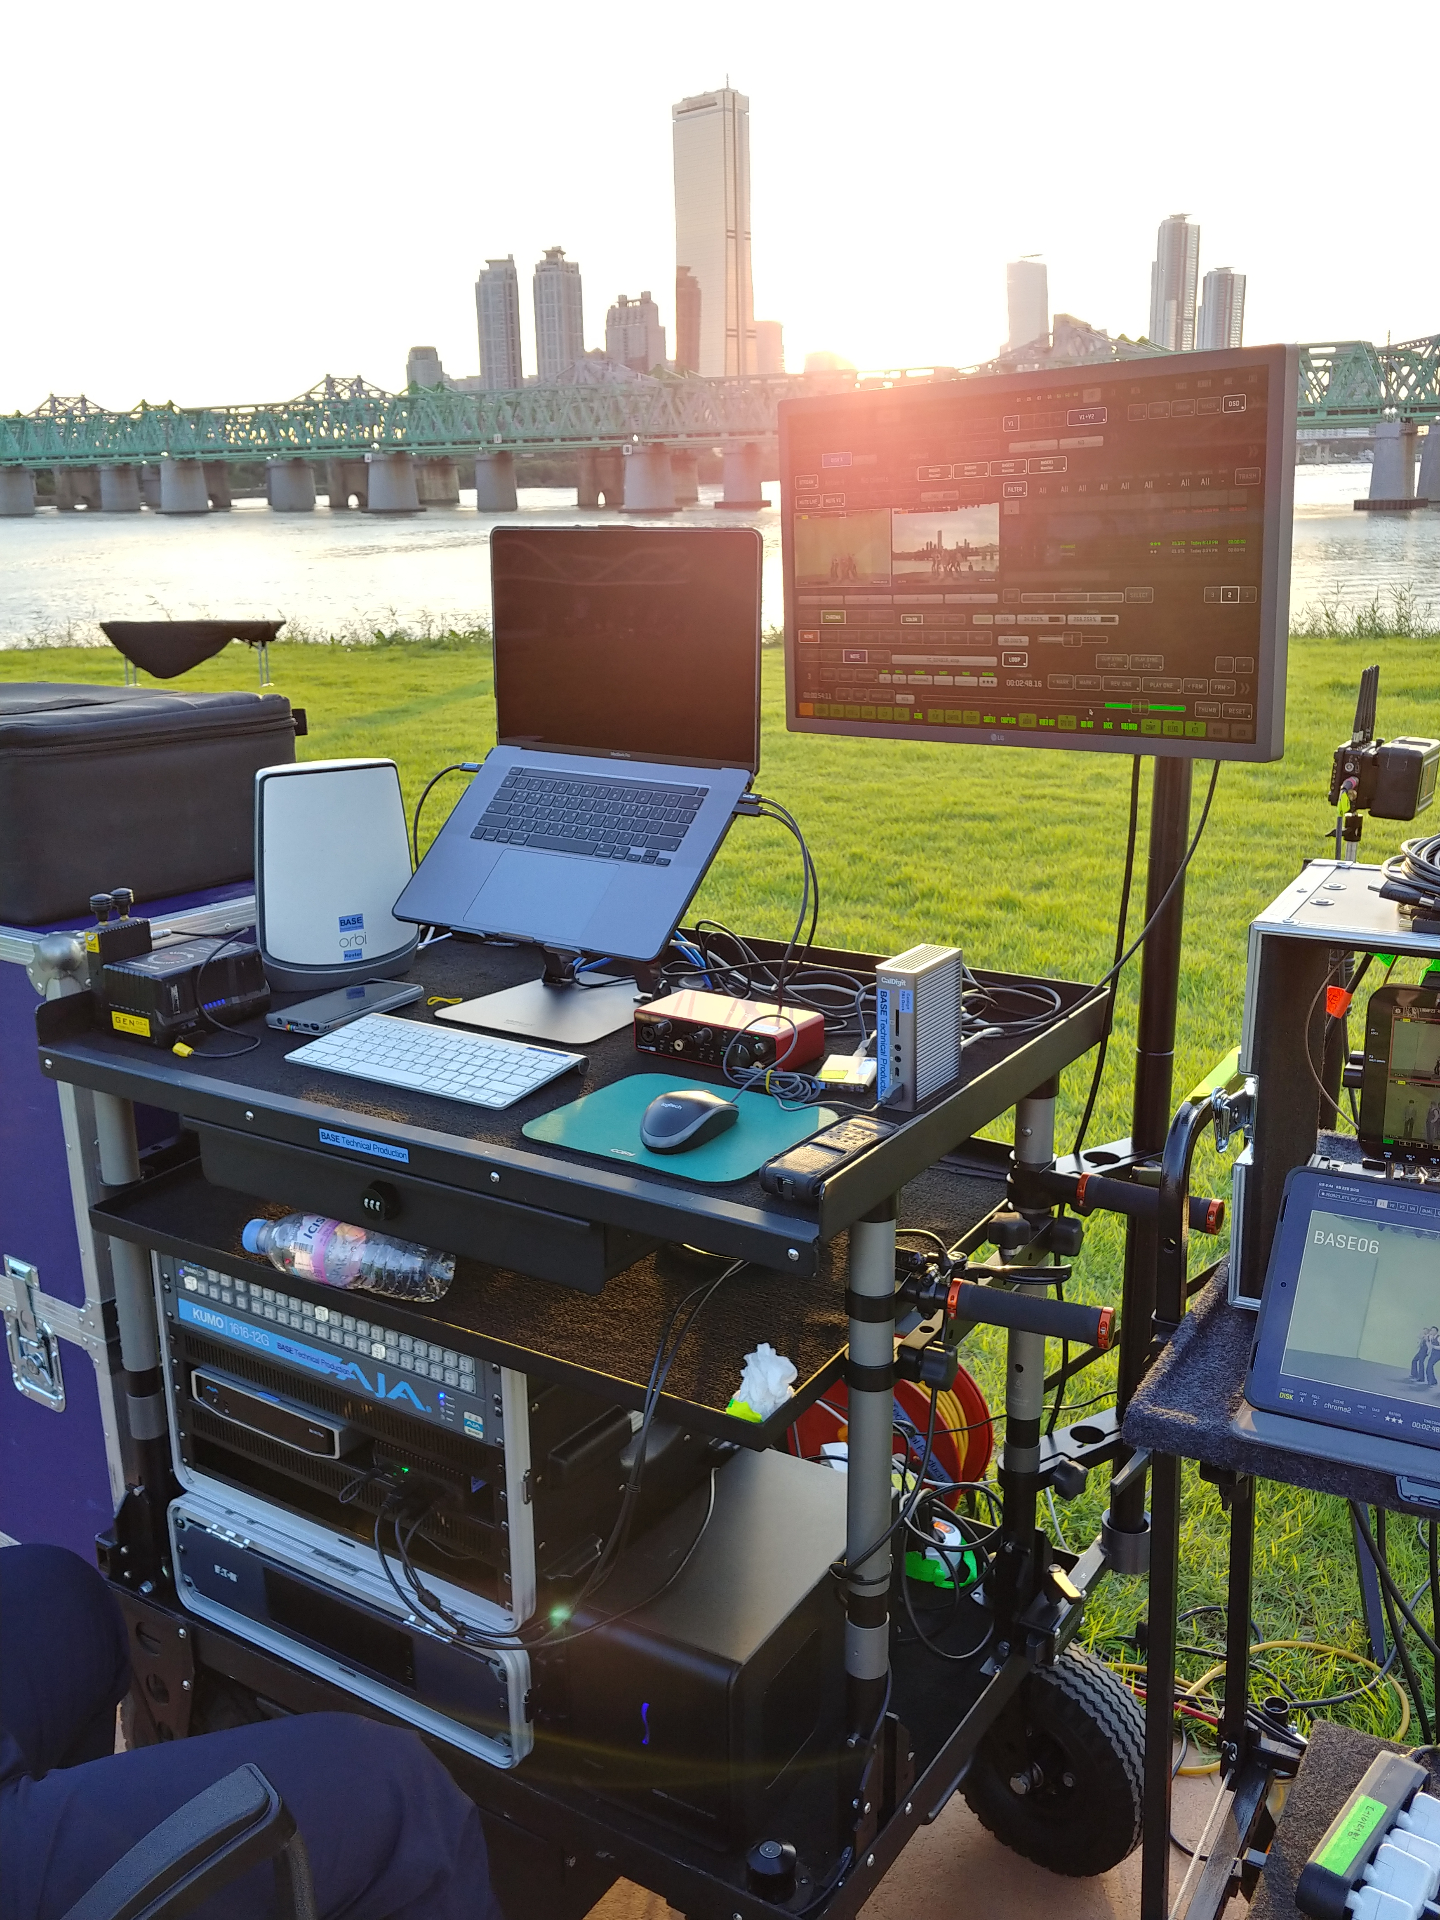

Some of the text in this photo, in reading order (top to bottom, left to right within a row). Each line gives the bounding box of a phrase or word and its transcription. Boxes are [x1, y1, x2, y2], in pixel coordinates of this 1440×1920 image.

[340, 916, 363, 926] BASE
[339, 931, 368, 948] orbi
[881, 976, 907, 987] CalDigit
[880, 990, 888, 1016] BASE
[115, 1016, 135, 1026] GEN
[879, 1018, 888, 1056] Technical
[660, 1101, 683, 1110] logitech
[321, 1131, 408, 1160] BASE Technical Production
[303, 1216, 327, 1239] ICIS
[1314, 1230, 1380, 1255] BASE06
[192, 1307, 224, 1329] KUMO
[229, 1322, 271, 1347] 1616-12G
[276, 1341, 351, 1376] BASE Technical Production
[338, 1361, 428, 1412] AJA
[1278, 1392, 1294, 1401] DISK
[1323, 1402, 1351, 1413] chroma2
